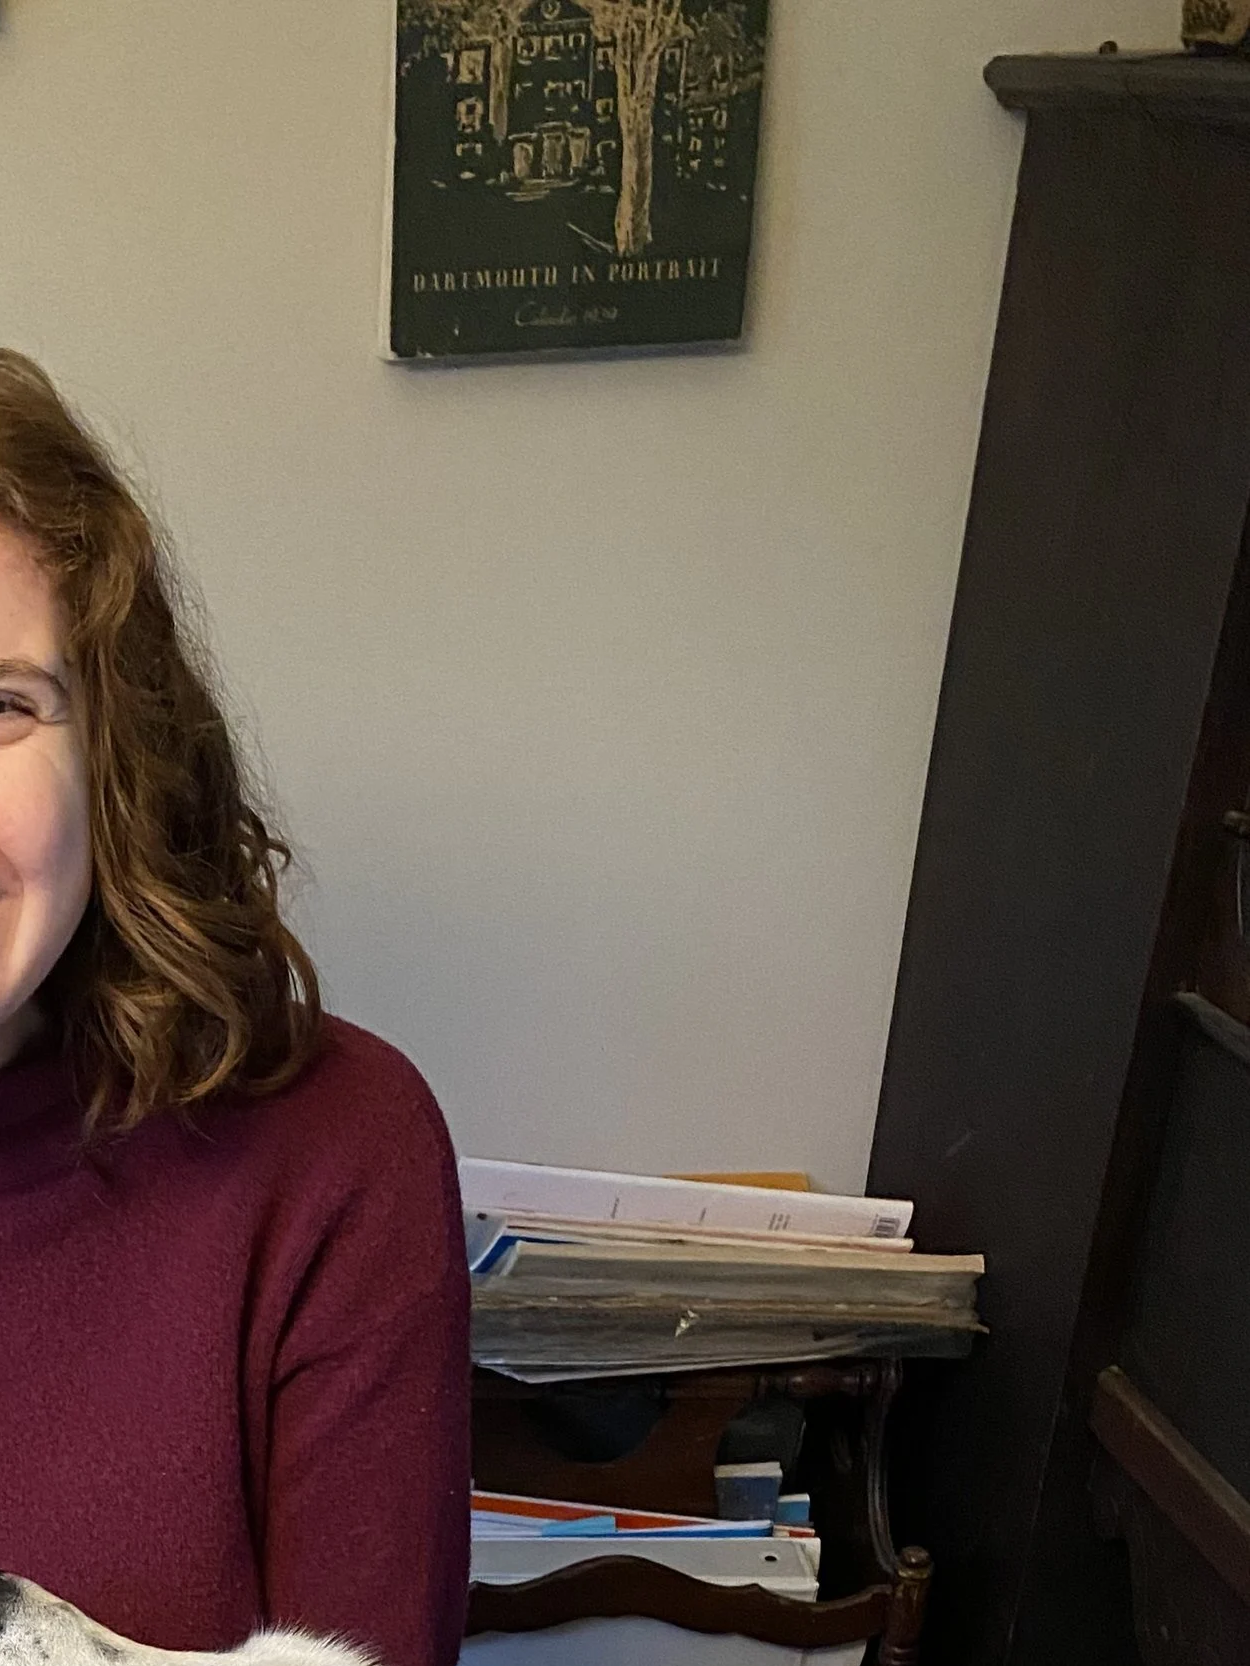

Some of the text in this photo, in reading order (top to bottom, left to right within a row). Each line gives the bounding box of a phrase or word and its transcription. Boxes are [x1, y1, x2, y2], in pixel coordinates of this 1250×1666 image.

[413, 257, 720, 293] DARTMOUTH IN PORTRAIT
